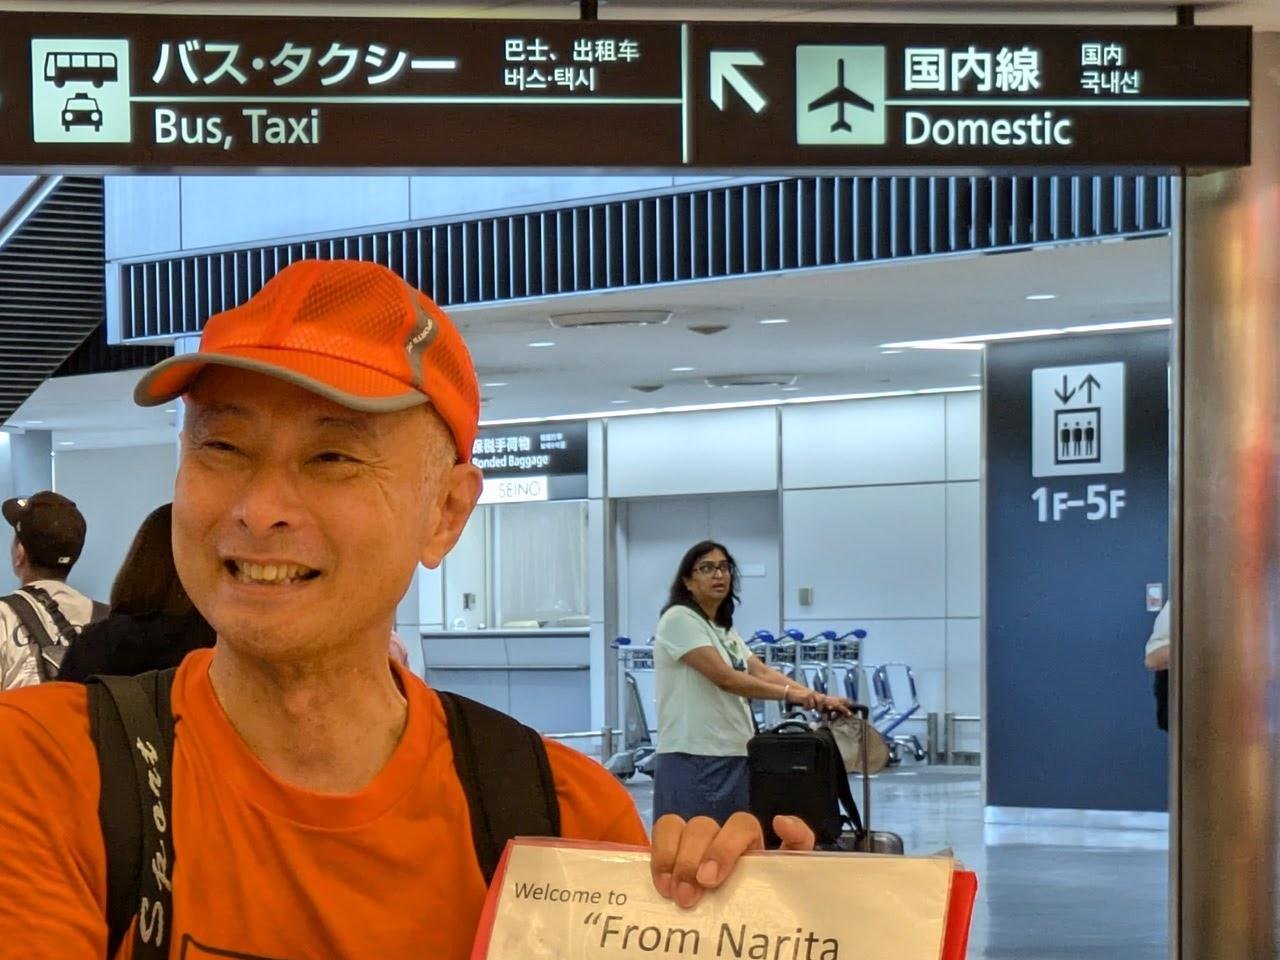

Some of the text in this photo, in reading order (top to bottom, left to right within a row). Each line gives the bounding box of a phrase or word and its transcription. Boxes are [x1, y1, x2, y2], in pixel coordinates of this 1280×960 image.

[151, 39, 457, 87] バス・タクシー
[1081, 43, 1122, 66] 国内
[504, 67, 595, 91] 버스·택시
[904, 46, 1041, 92] 国内線
[1080, 70, 1141, 94] 국내선
[154, 109, 319, 150] Bus, Taxi
[905, 113, 1072, 146] Domestic
[508, 455, 549, 469] Baggage
[498, 481, 541, 498] SEINO
[136, 736, 172, 947] Sport
[514, 882, 628, 906] Welcome to
